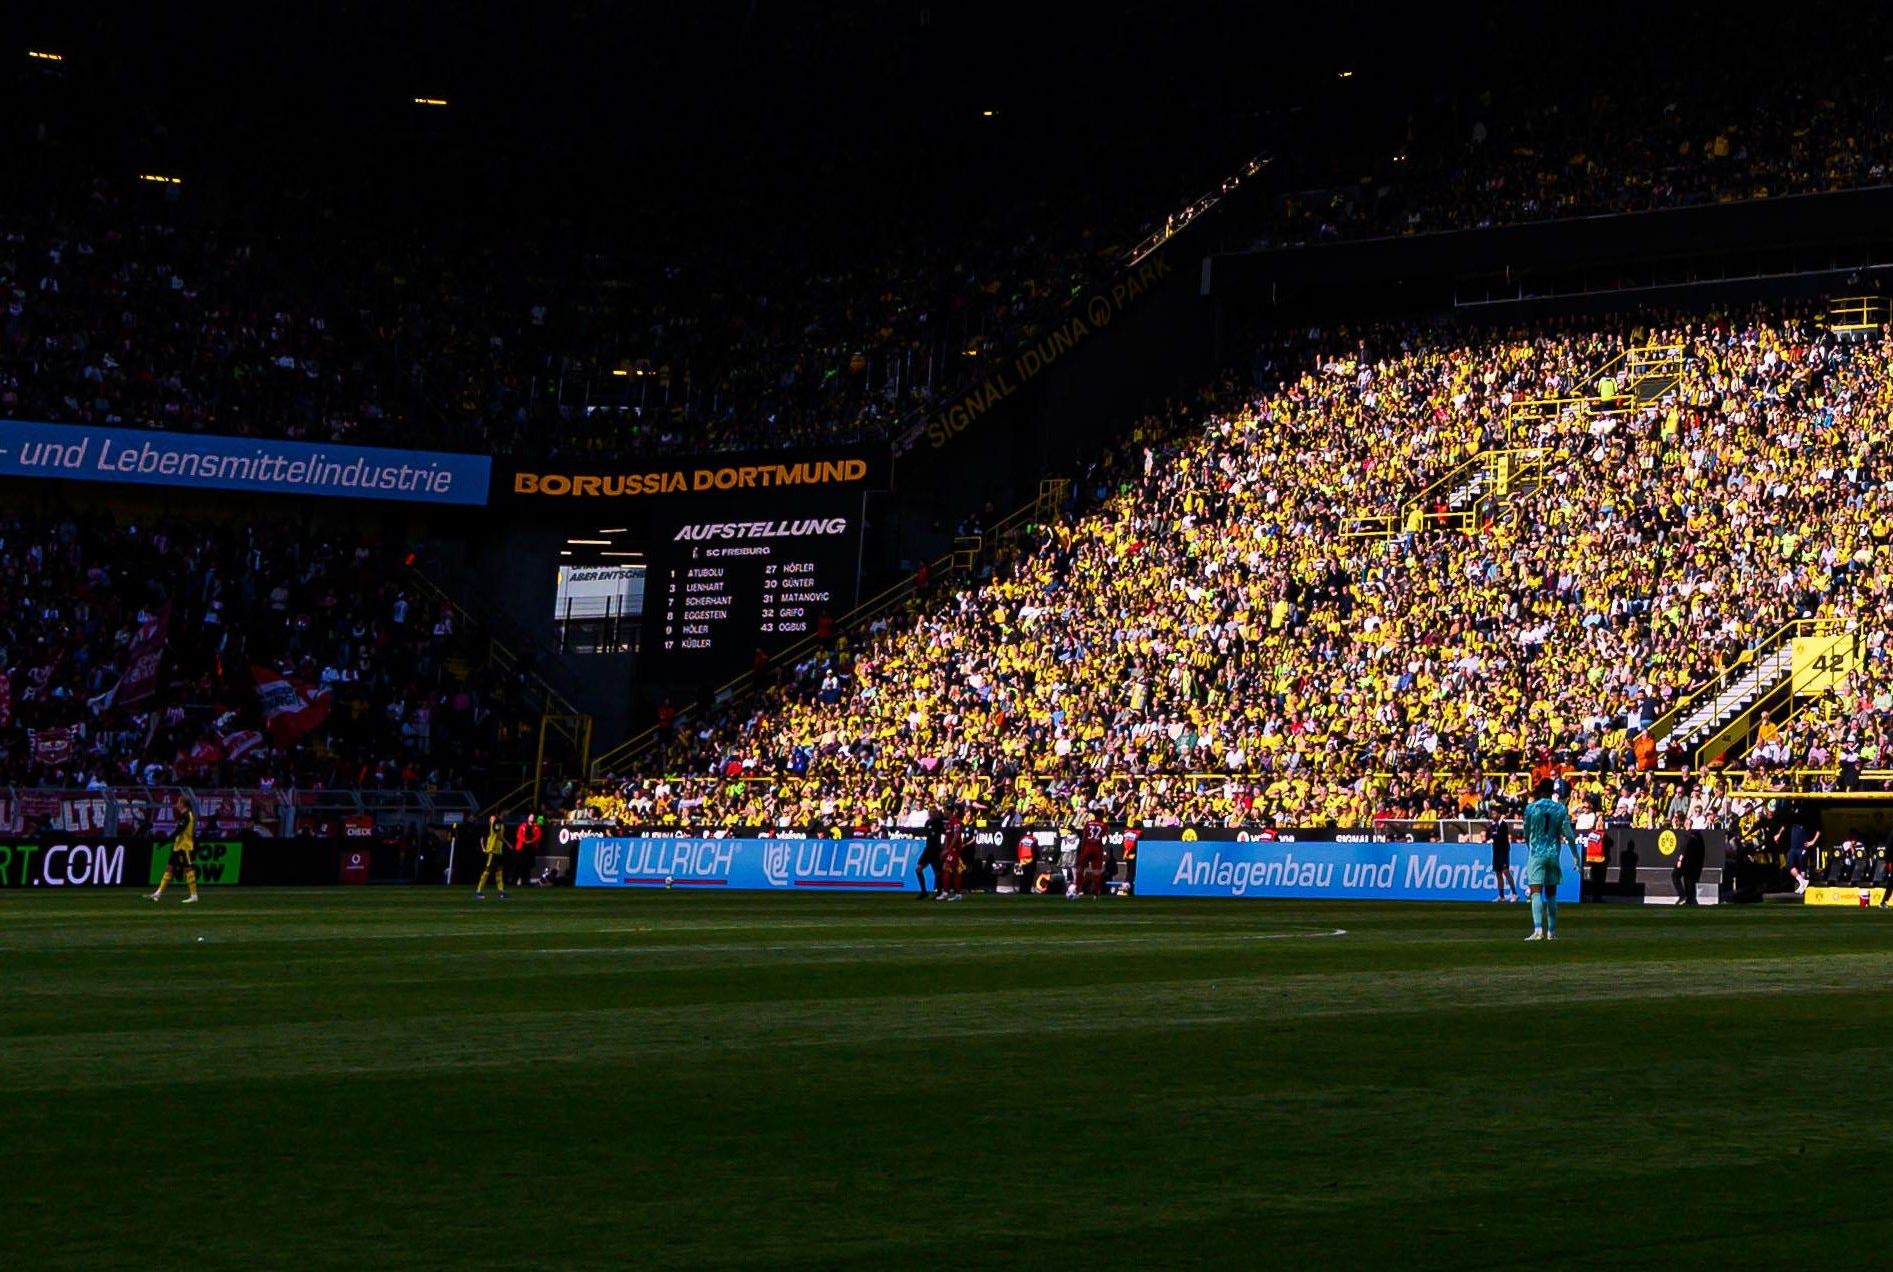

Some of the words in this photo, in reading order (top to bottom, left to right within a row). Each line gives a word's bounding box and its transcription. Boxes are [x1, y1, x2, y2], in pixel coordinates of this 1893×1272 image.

[925, 374, 1018, 449] SIGNAL
[1014, 315, 1091, 384] IDUNA
[1111, 256, 1172, 311] PARK
[19, 436, 89, 468] und
[97, 438, 453, 494] Lebensmittelindustrie
[513, 473, 688, 496] BORUSSIA
[692, 459, 867, 491] DORTMUND
[673, 517, 847, 542] AUFSTELLUNG
[706, 548, 720, 557] SC
[721, 546, 771, 556] FREIBURG
[671, 570, 676, 578] 1
[765, 565, 777, 574] 27
[569, 571, 598, 582] ABER
[669, 584, 676, 593] 3
[686, 582, 724, 593] LIENHART
[764, 579, 777, 589] 30
[668, 598, 674, 606] 7
[685, 596, 733, 606] SCHERHANT
[763, 594, 773, 603] 31
[684, 610, 727, 620] EGGESTEIN
[762, 609, 774, 617] 32
[779, 607, 804, 618] GRIFO
[760, 623, 773, 632] 43
[664, 640, 674, 649] 17
[1811, 654, 1844, 673] 42
[625, 841, 735, 876] ULLRICH
[794, 842, 912, 877] ULLRICH
[1172, 851, 1334, 896] Anlagenbau
[1342, 854, 1398, 888] und
